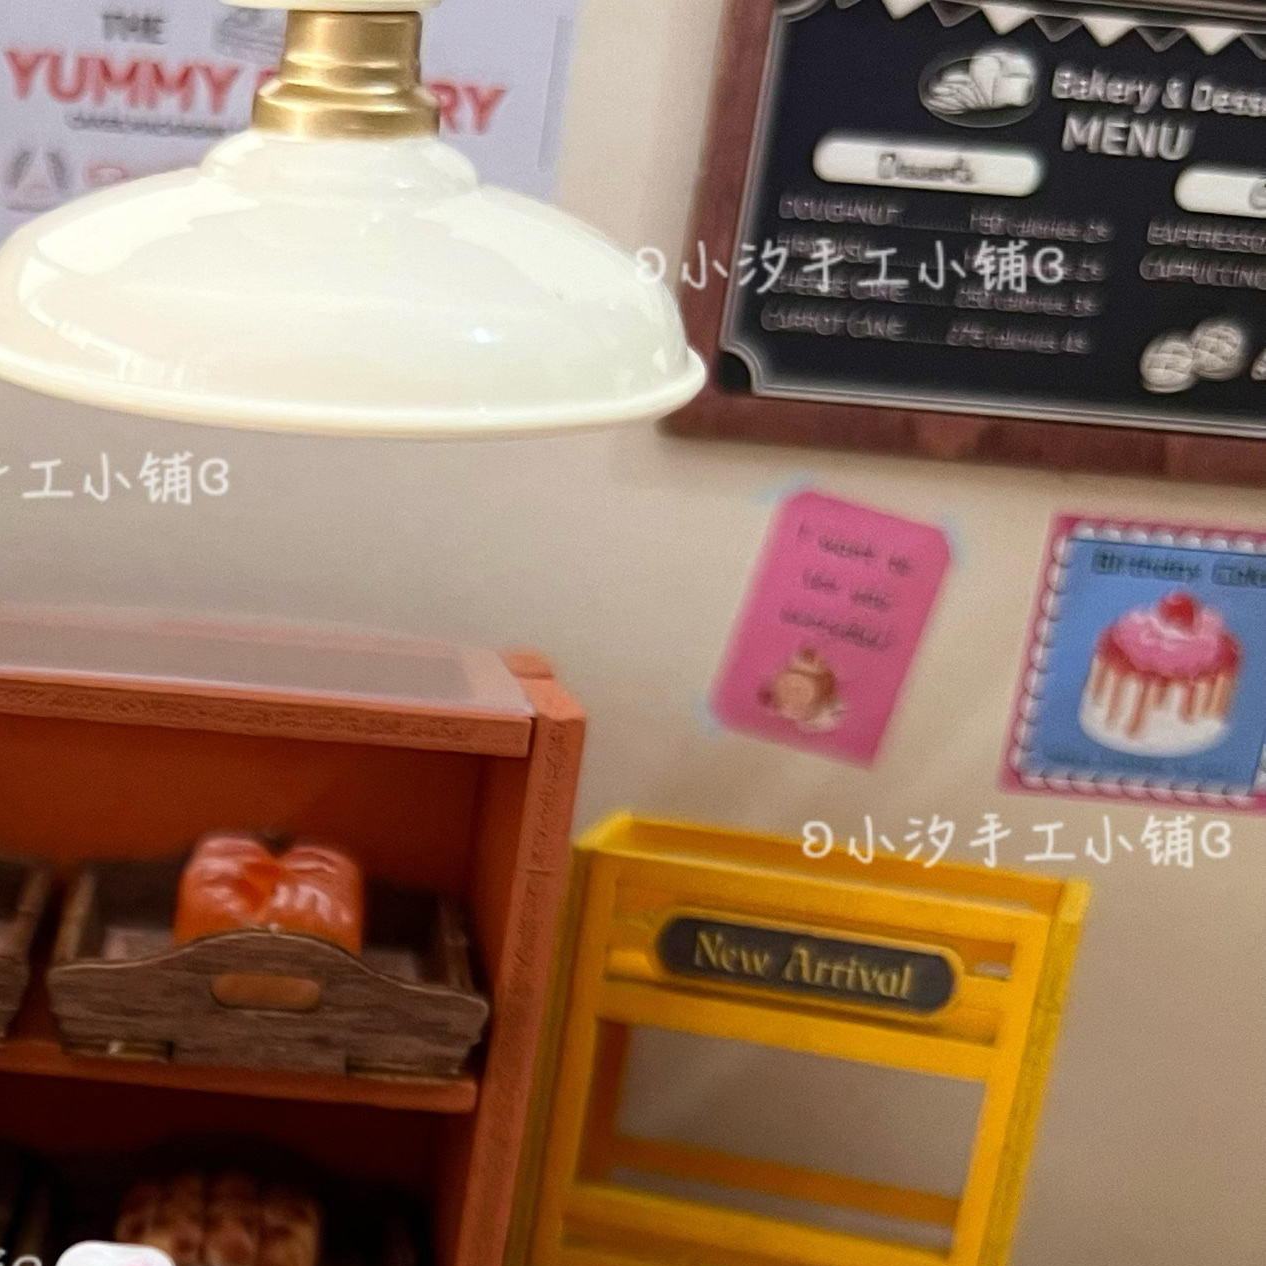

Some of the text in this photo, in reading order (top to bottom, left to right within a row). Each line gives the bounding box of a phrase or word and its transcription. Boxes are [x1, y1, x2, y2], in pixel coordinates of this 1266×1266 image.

[103, 11, 168, 45] THE
[3, 47, 239, 115] YUMMY
[1062, 113, 1197, 160] MENU
[694, 931, 913, 999] New Arrival
